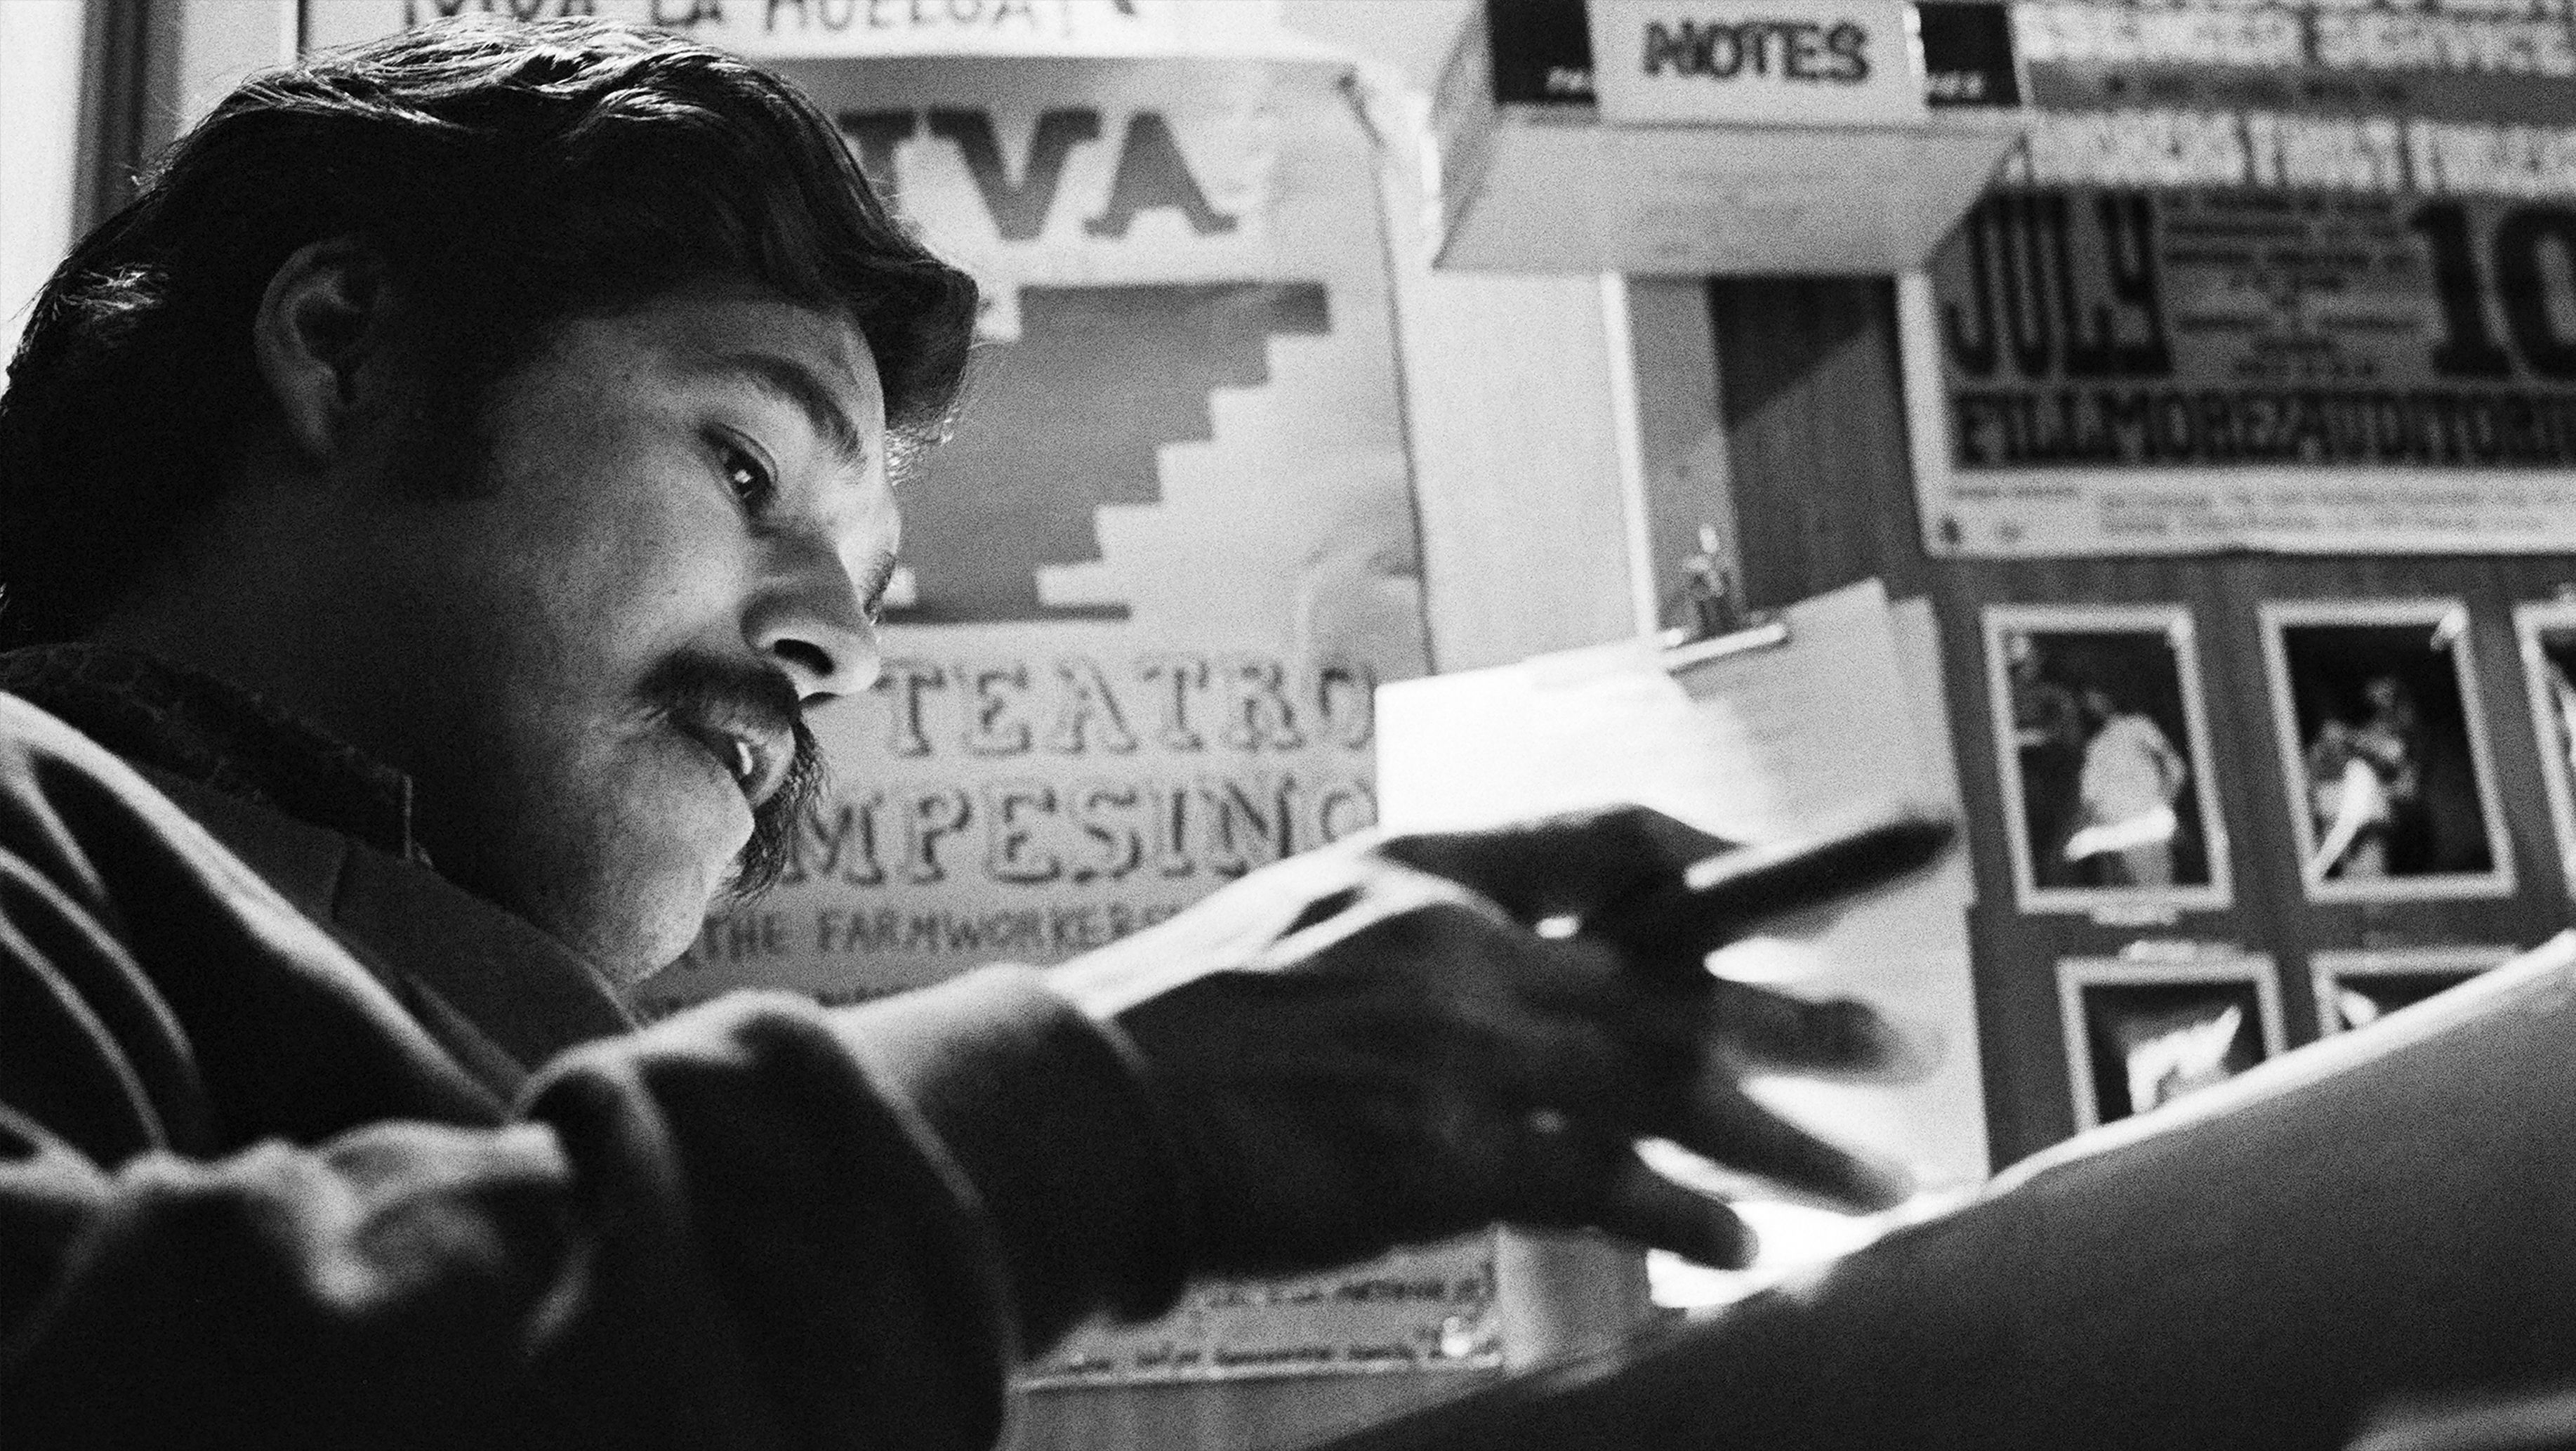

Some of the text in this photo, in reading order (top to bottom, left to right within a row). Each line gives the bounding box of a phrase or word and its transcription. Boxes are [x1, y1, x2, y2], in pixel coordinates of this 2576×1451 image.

[1642, 18, 1871, 85] NOTES
[843, 105, 1238, 242] IVA
[1946, 191, 2174, 379] JULY
[2410, 198, 2576, 379] 10
[1955, 389, 2272, 466] FILLMORE
[873, 655, 1376, 759] TEATRO
[781, 769, 1378, 886] MPESINO
[702, 912, 785, 962] THE
